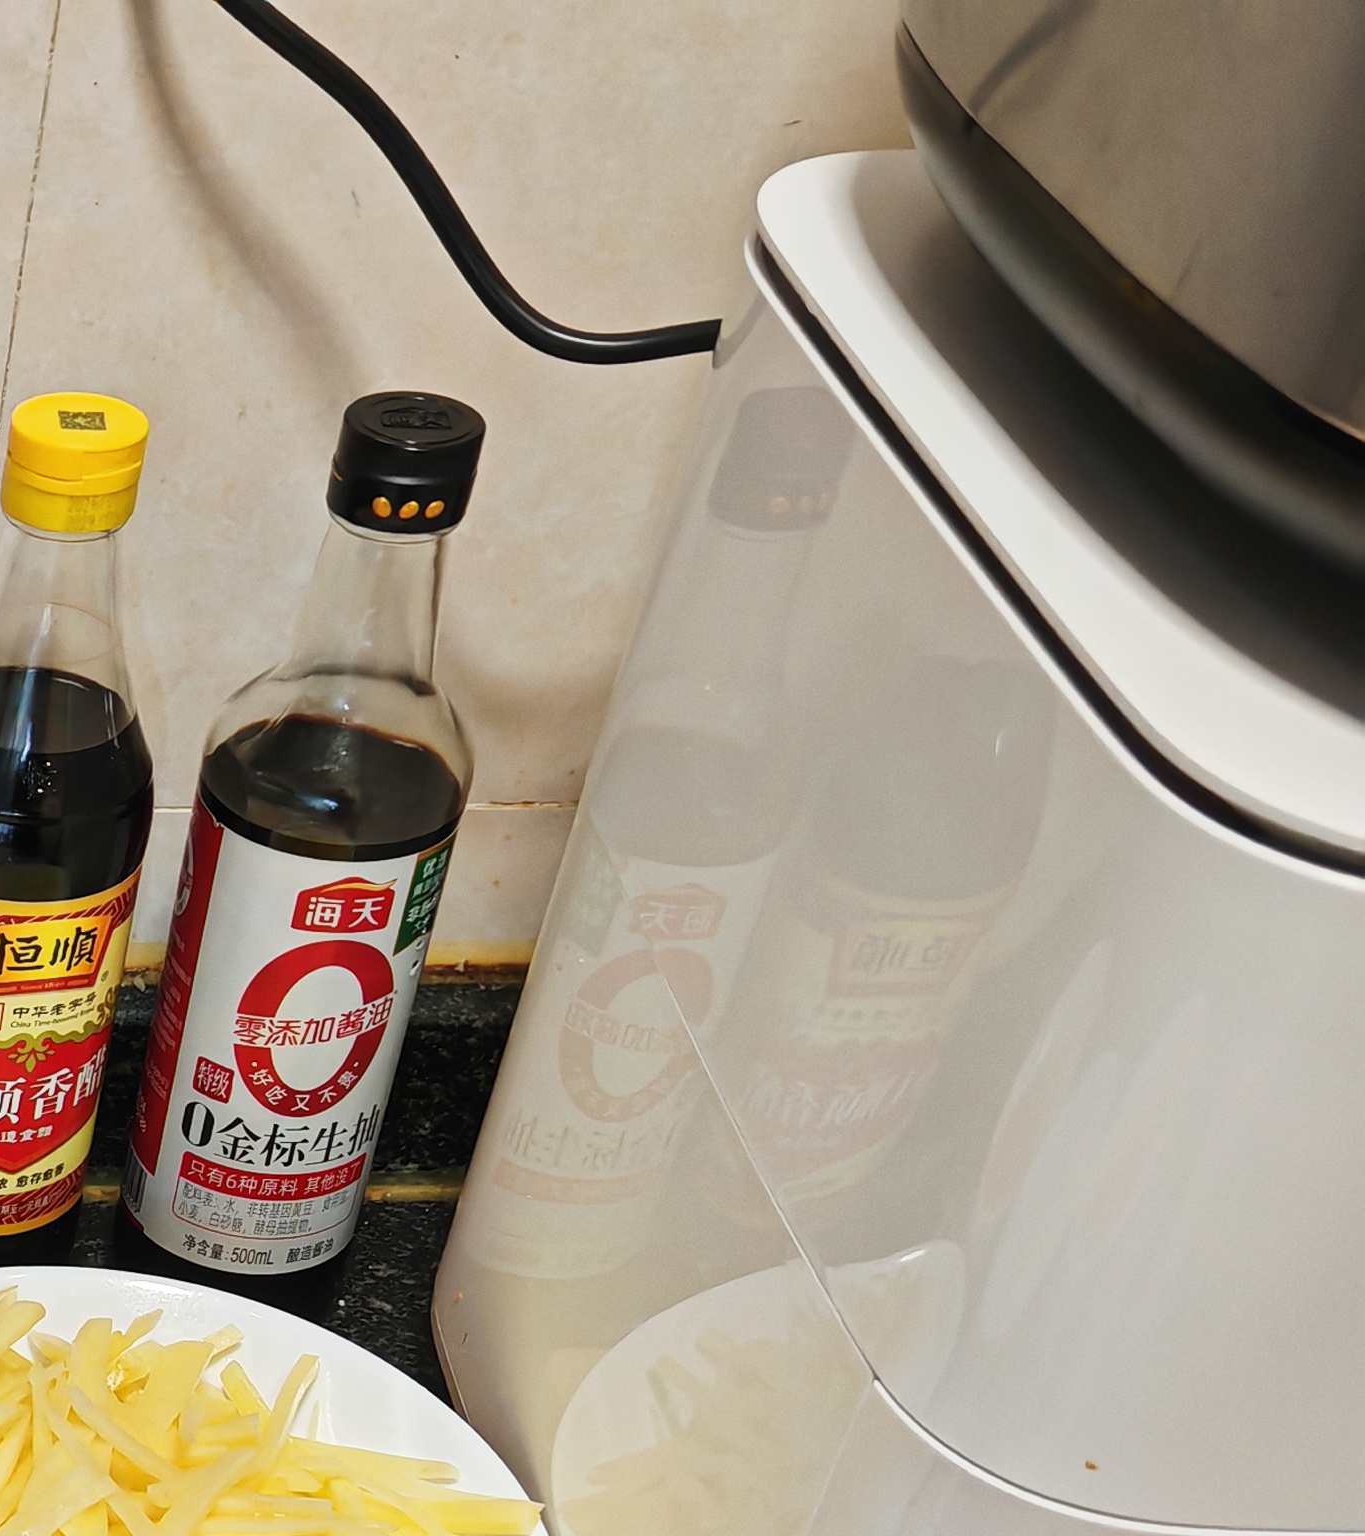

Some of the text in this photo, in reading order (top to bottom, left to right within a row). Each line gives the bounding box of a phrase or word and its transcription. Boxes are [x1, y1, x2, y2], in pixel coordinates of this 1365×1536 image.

[305, 896, 386, 928] 海天
[12, 991, 97, 1019] 中华老字号
[233, 997, 393, 1046] 零添加酱油
[197, 1063, 230, 1098] 特级
[181, 1101, 380, 1167] 0金标生抽
[15, 1163, 65, 1188] 愈存愈香
[188, 1160, 361, 1196] 只有6种原料 其他没了
